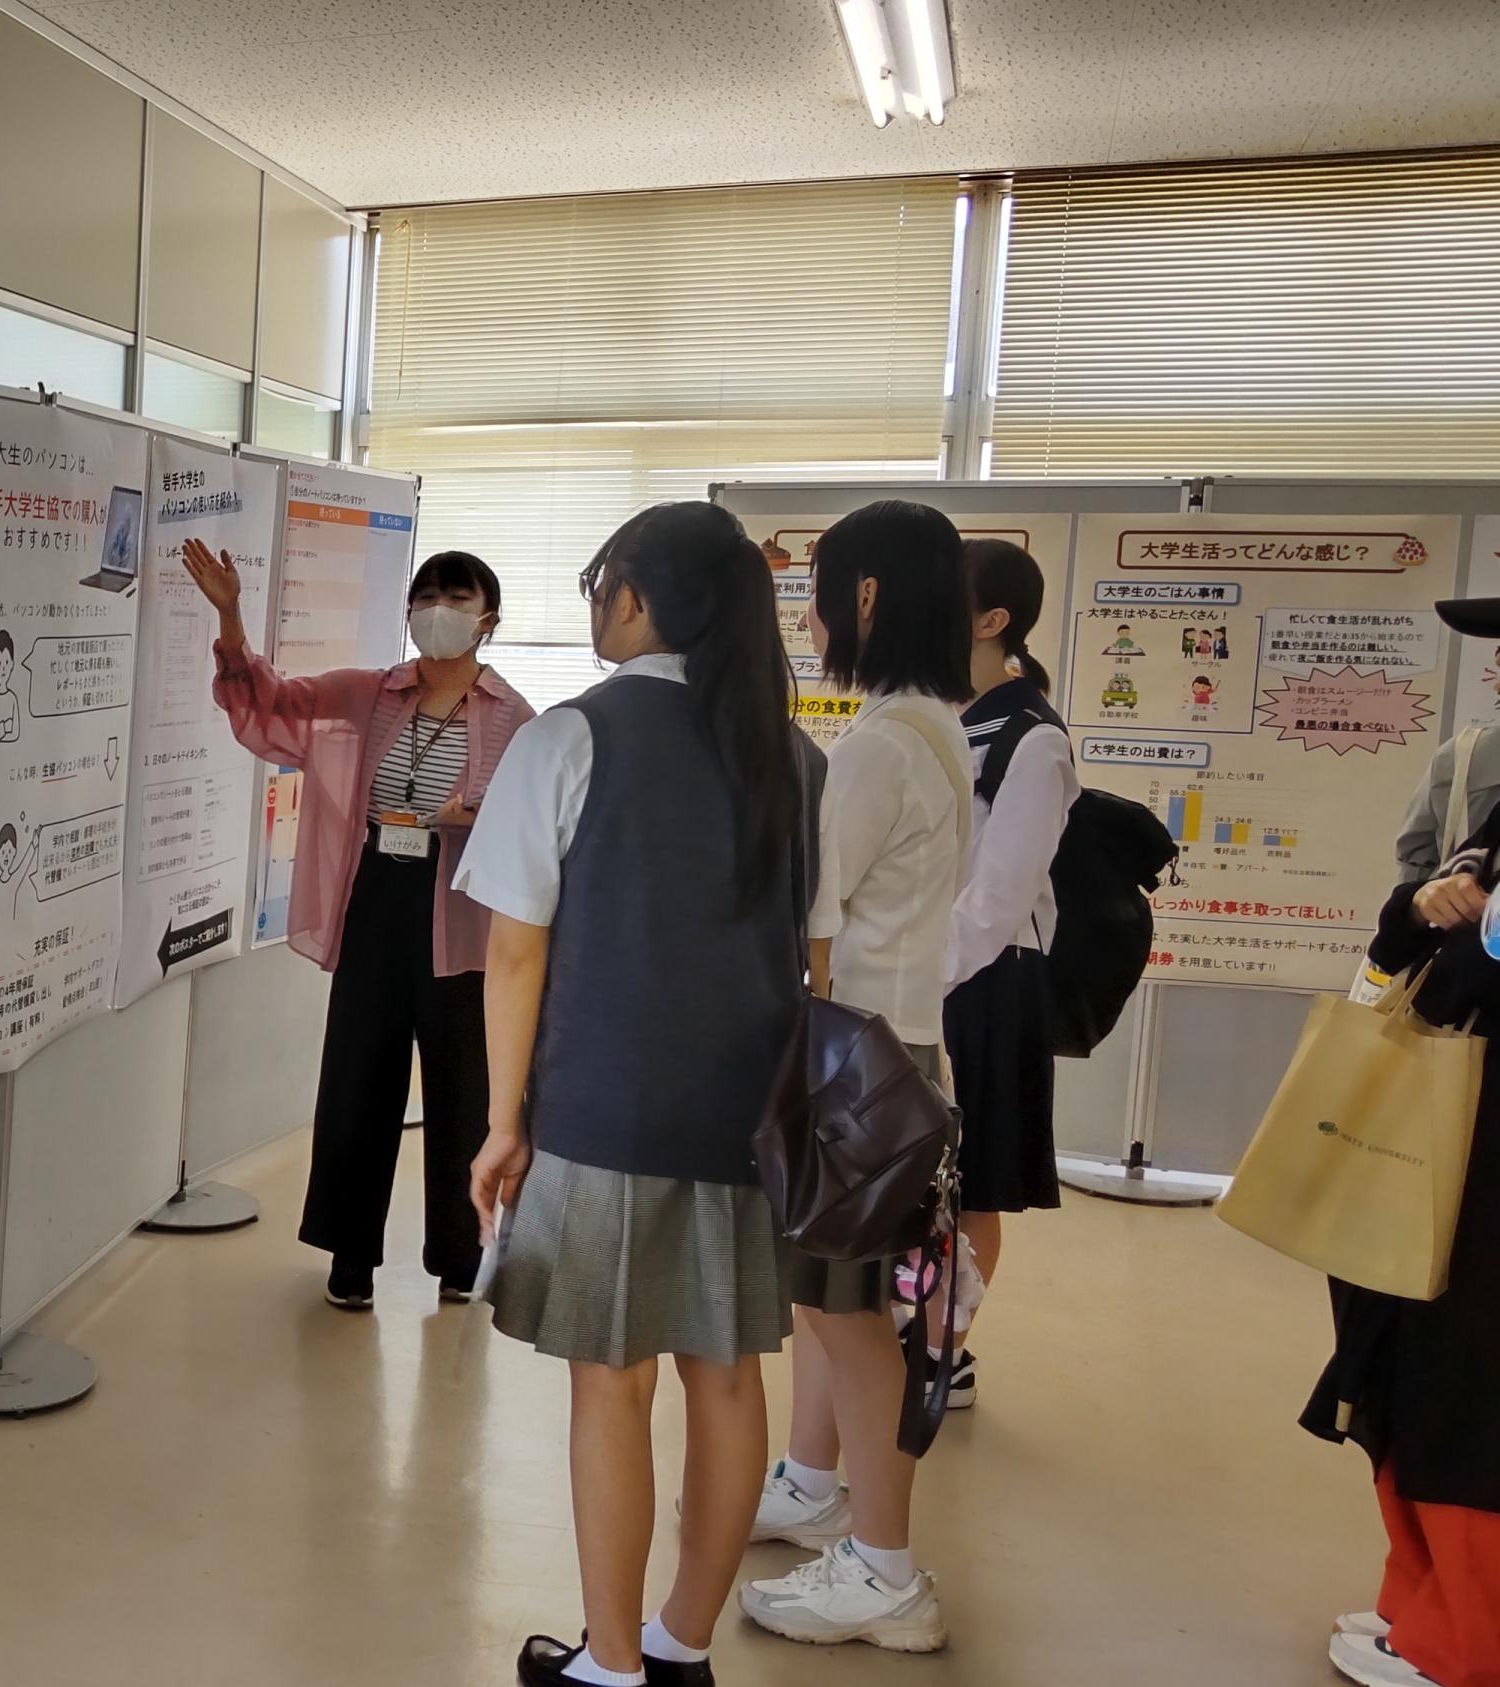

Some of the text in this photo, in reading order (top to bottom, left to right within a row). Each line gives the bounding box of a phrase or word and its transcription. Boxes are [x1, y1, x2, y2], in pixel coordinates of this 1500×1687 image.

[162, 470, 205, 492] 岩手大学生の
[1140, 541, 1369, 563] 大学生活ってどんな感じ？
[1103, 585, 1225, 601] 大学生のごはん事情
[1087, 607, 1227, 621] 大学生はやることたくさん！
[1289, 613, 1414, 626] 忙しくて食生活が乱れがち
[1191, 660, 1221, 669] サークル
[1099, 709, 1139, 719] 自動車学校
[1294, 719, 1395, 733] 最悪の場合食べない
[1089, 744, 1197, 760] 大学生の出費は？
[1196, 771, 1265, 782] 節約したい項目
